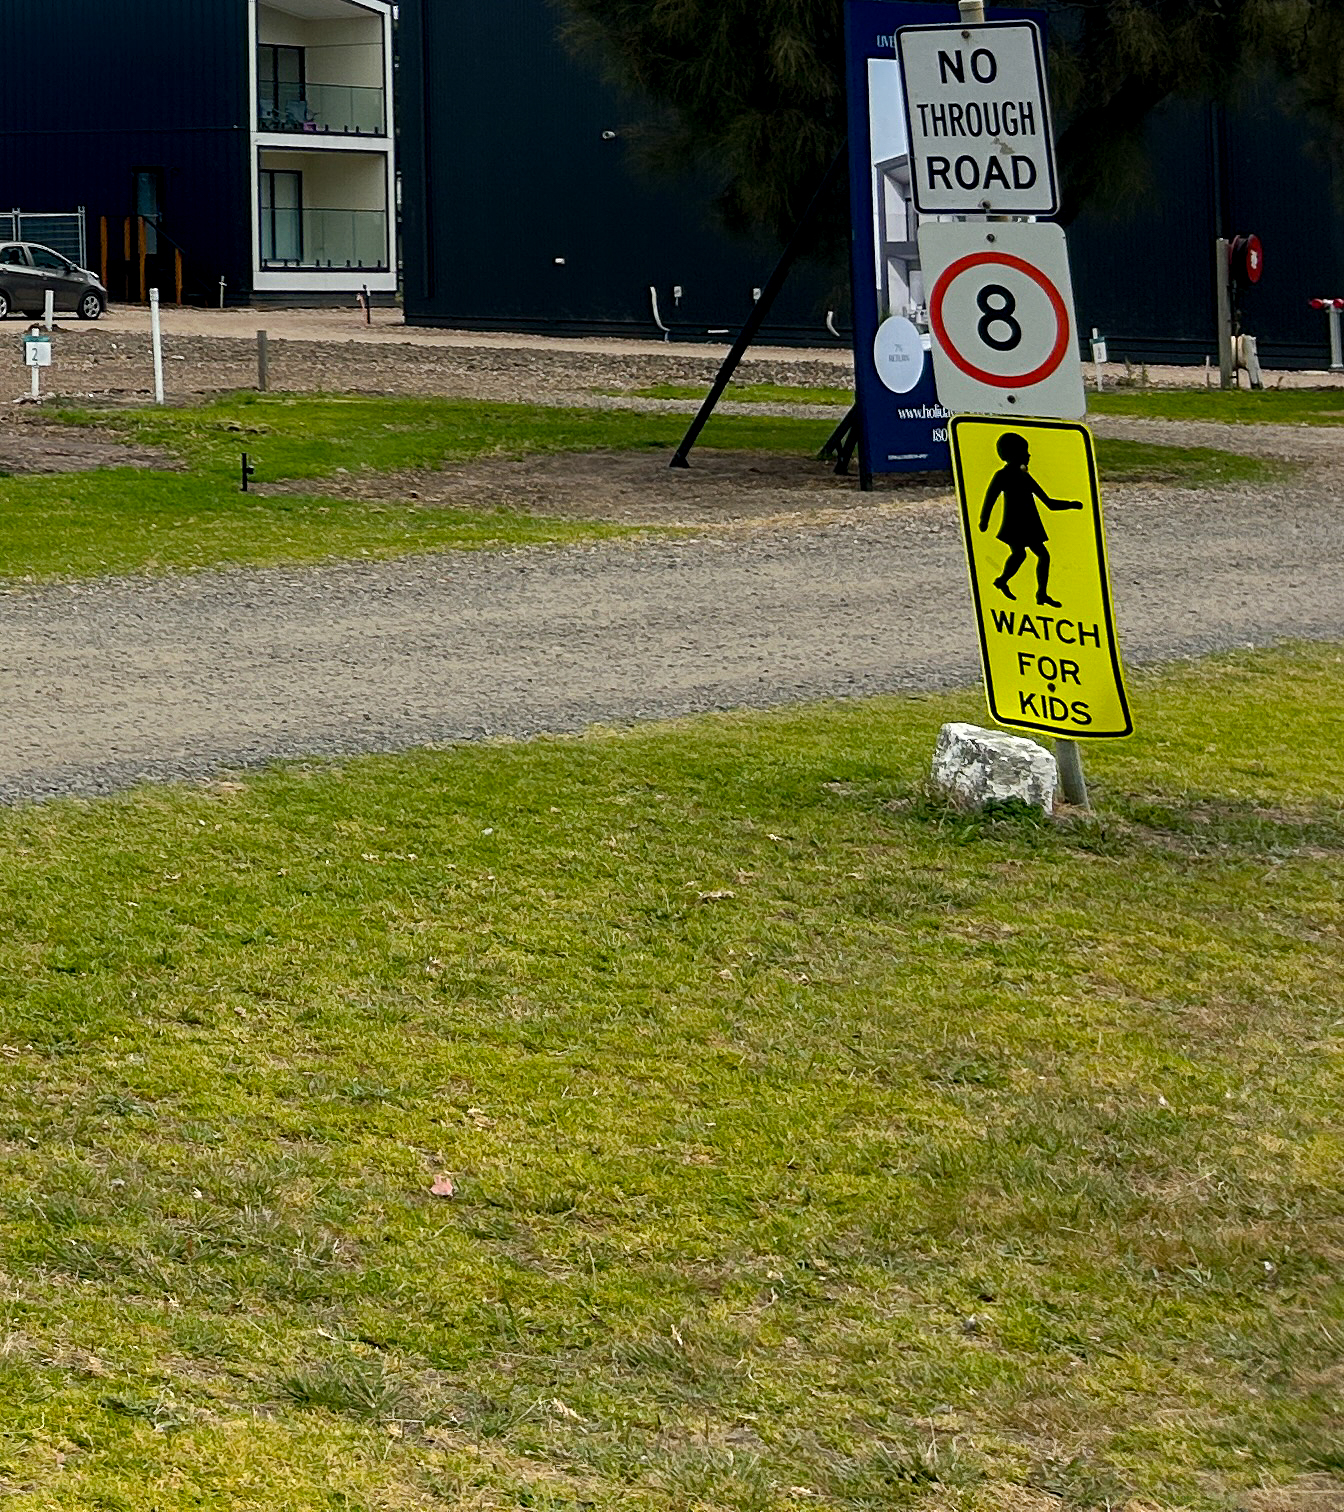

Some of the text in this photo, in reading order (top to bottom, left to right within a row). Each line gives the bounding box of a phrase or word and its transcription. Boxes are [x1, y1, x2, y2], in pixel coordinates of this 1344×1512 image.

[937, 48, 998, 84] NO
[916, 101, 1036, 137] THROUGH
[926, 154, 1037, 190] ROAD
[976, 283, 1022, 352] 8
[31, 347, 39, 361] 2
[932, 428, 948, 442] 180
[990, 608, 1101, 649] WATCH
[1017, 651, 1082, 686] FOR
[1018, 690, 1092, 725] KIDS
